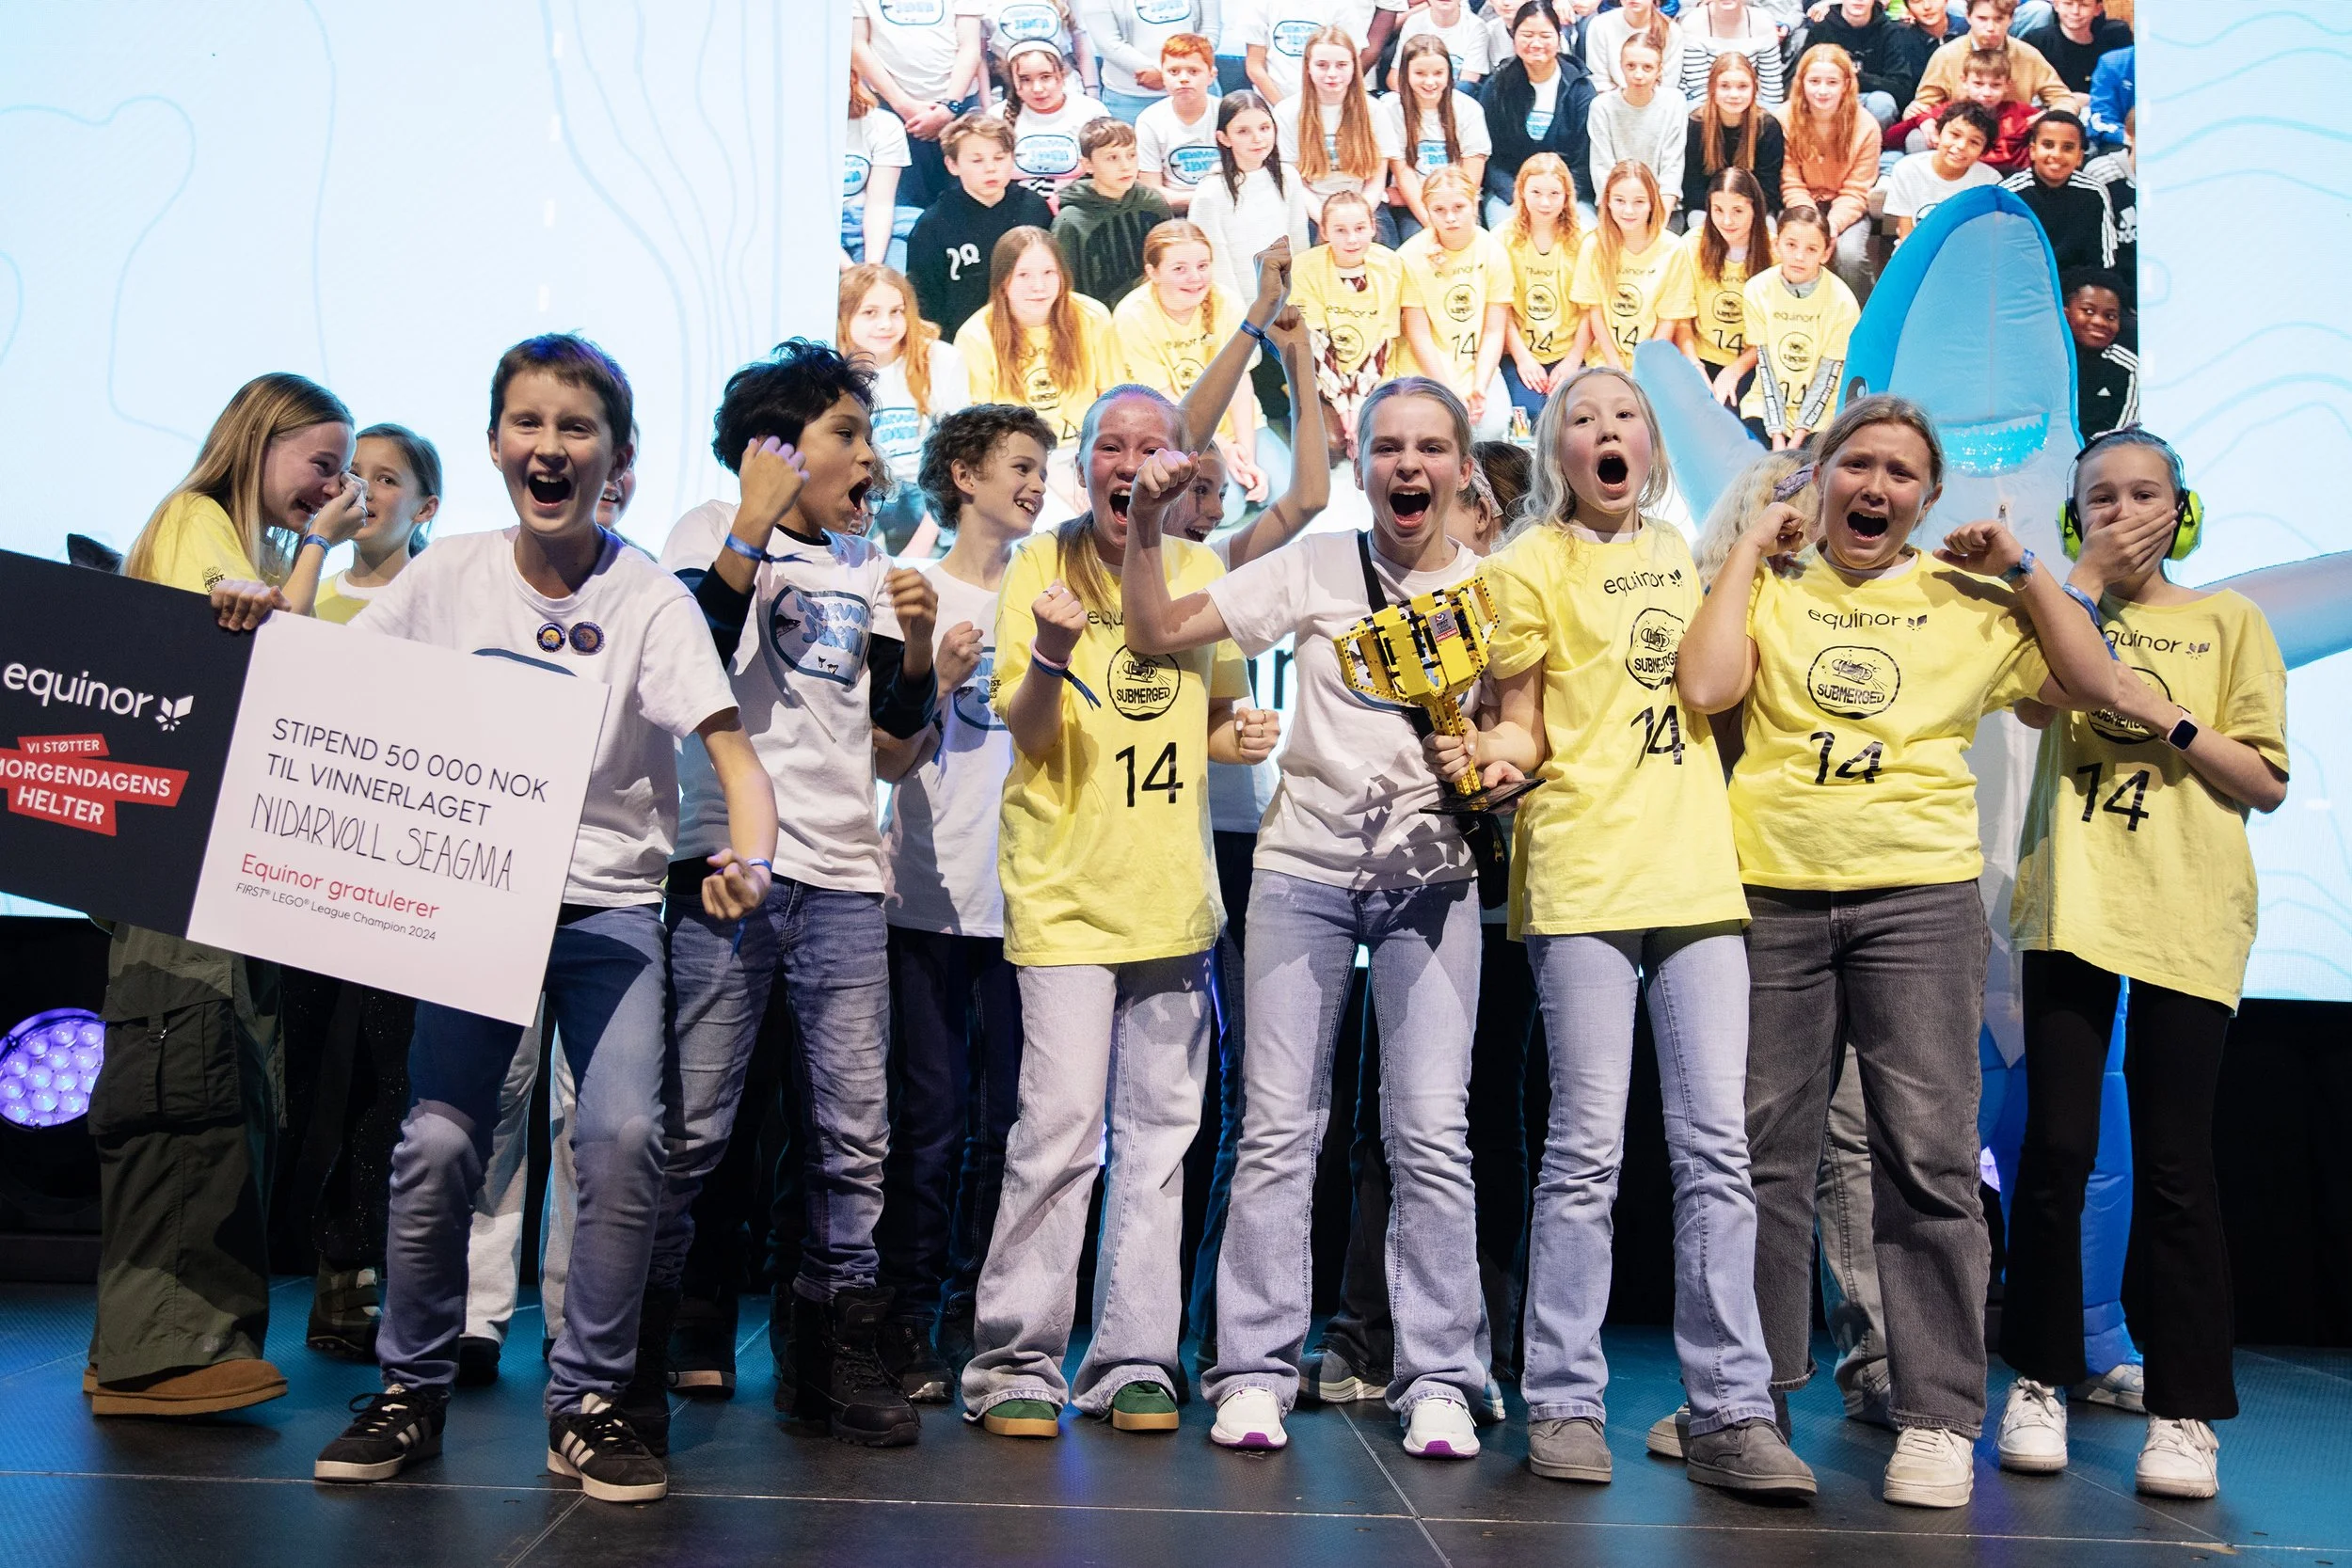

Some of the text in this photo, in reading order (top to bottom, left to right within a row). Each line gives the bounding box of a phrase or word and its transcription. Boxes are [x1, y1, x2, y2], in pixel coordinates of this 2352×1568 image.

[1452, 331, 1478, 361] 14
[1526, 329, 1553, 353] 14
[1712, 328, 1744, 357] 14
[1603, 571, 1664, 596] equinor
[1807, 608, 1901, 630] equinor
[2105, 629, 2183, 653] quinor
[1634, 651, 1677, 673] SUBMERG
[3, 662, 154, 718] equinor
[1117, 687, 1170, 704] SUBMERGED
[1817, 683, 1885, 705] SUBMERGED
[26, 739, 100, 753] VI STØTTER
[1630, 705, 1686, 769] 14
[272, 718, 548, 803] STIPEND 50 000 NOK
[1115, 741, 1184, 808] 14
[1809, 731, 1883, 784] 14
[0, 759, 171, 798] ORGENDAGENS
[268, 752, 492, 826] TIL VINNERLAGET
[2076, 762, 2151, 832] 14
[17, 785, 104, 825] HELTER
[250, 793, 512, 892] NIDARVOLL SEAGMA
[242, 853, 440, 919] Equinor gratulerer
[310, 901, 351, 920] League
[353, 911, 406, 934] Champion
[408, 925, 437, 942] 2024
